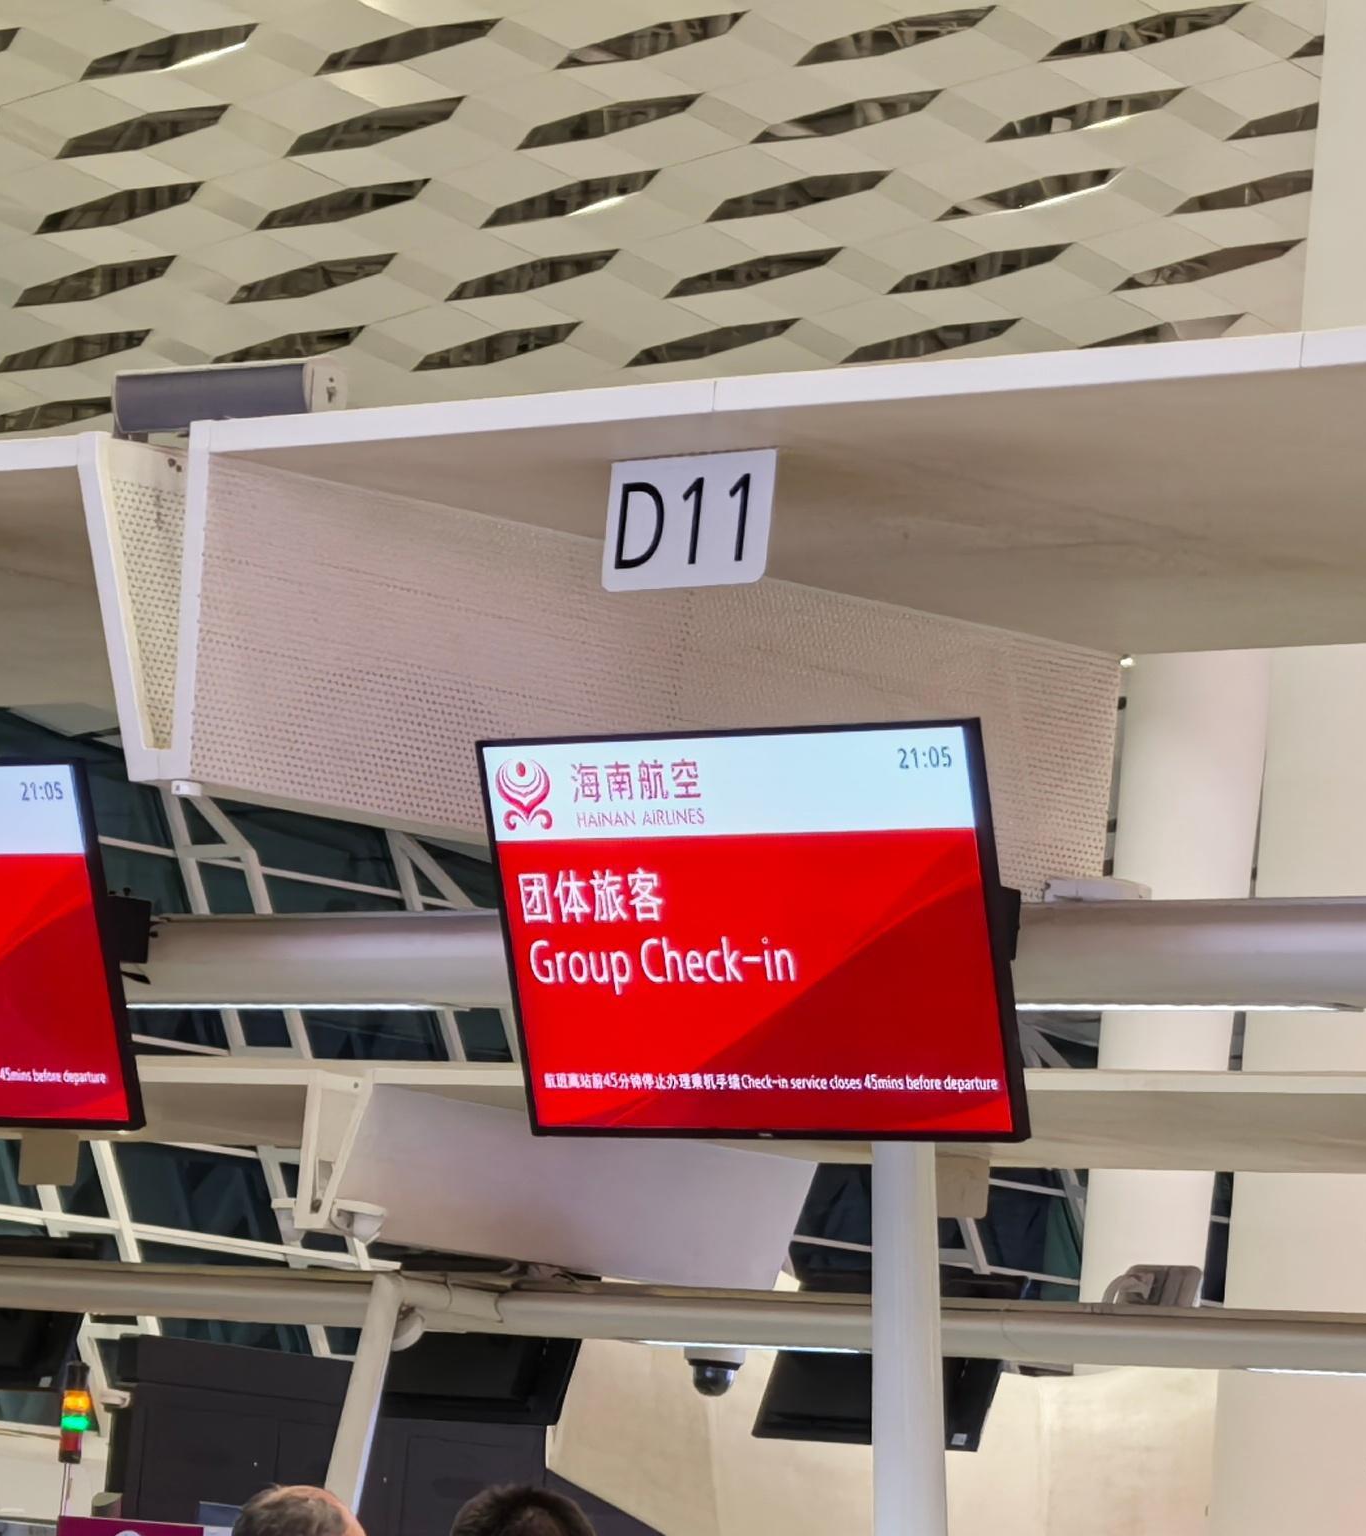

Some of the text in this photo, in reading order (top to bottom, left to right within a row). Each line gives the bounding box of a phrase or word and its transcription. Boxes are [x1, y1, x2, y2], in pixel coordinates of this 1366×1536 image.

[614, 473, 751, 569] D11
[897, 745, 953, 769] 21:05
[20, 780, 64, 802] 21:05
[570, 759, 702, 803] 海南航空
[577, 808, 705, 828] HAINAN AIRLINES
[517, 868, 664, 924] 团体旅客
[529, 935, 797, 993] Group Check-in
[741, 1073, 788, 1091] Check-in
[790, 1075, 828, 1091] service
[829, 1074, 862, 1091] closes
[864, 1074, 904, 1091] 45mins
[906, 1074, 941, 1092] before
[944, 1075, 999, 1094] departure
